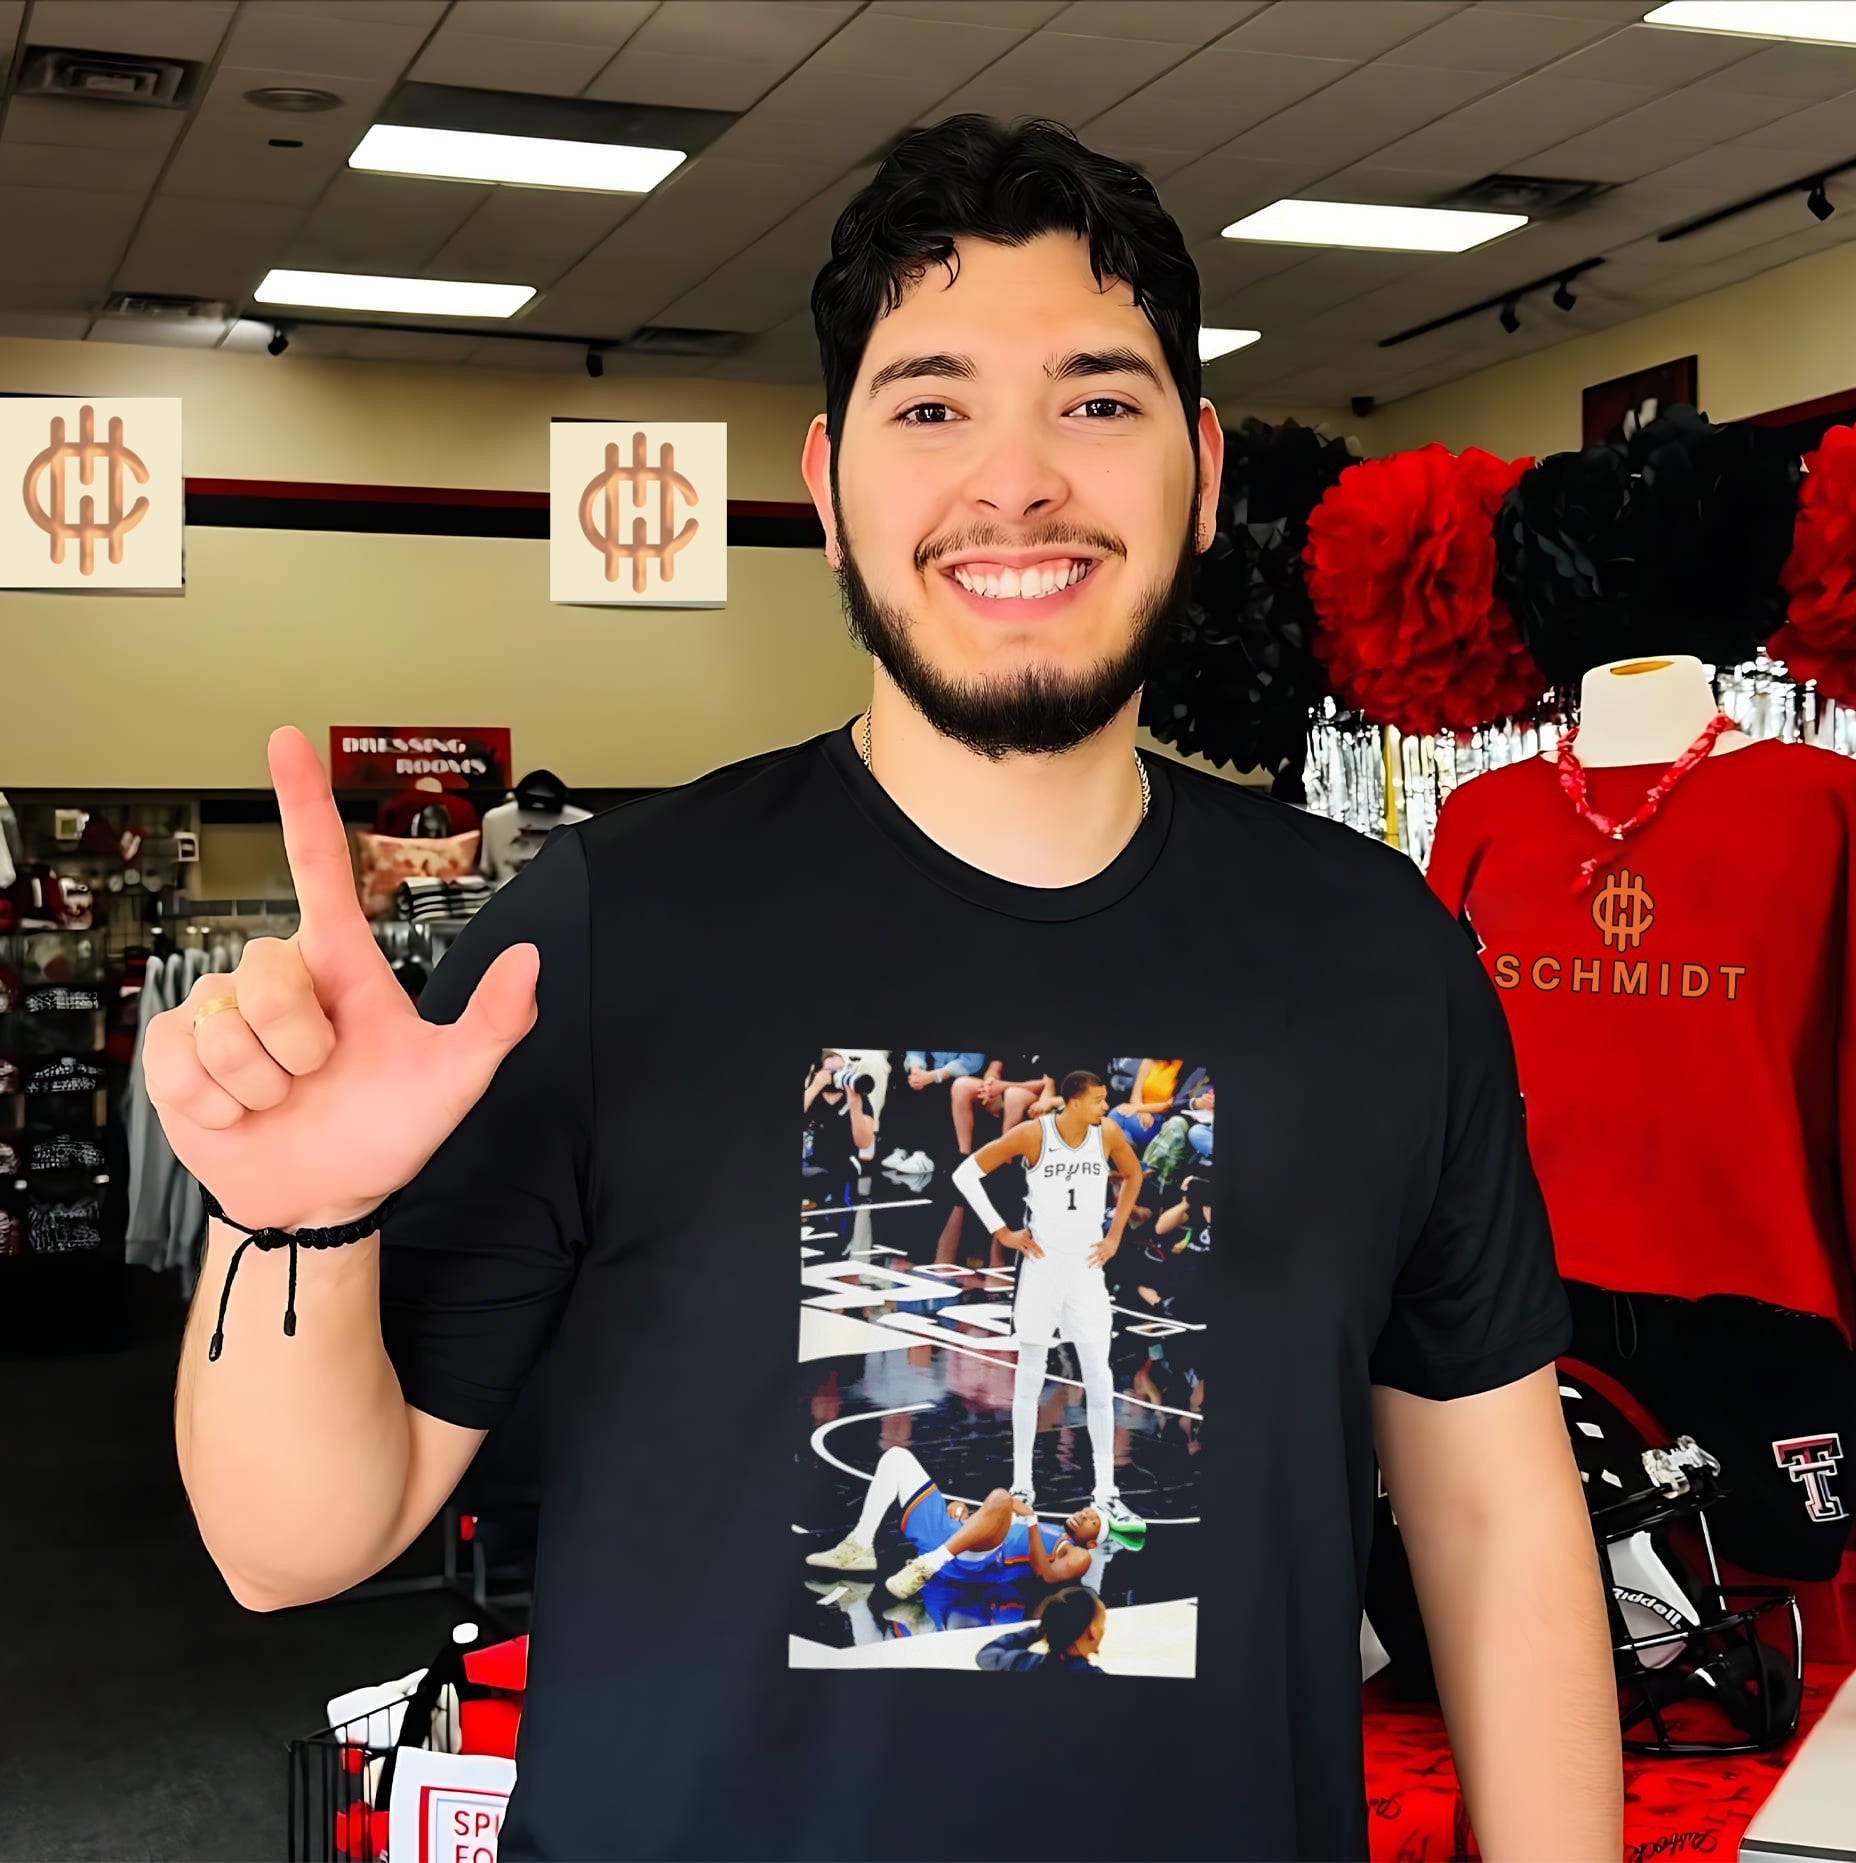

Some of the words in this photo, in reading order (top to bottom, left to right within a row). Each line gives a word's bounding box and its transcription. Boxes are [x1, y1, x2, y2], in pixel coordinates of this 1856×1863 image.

[1494, 953, 1747, 1000] SCHMIDT
[1043, 1162, 1101, 1181] SPURS
[1067, 1188, 1077, 1211] 1
